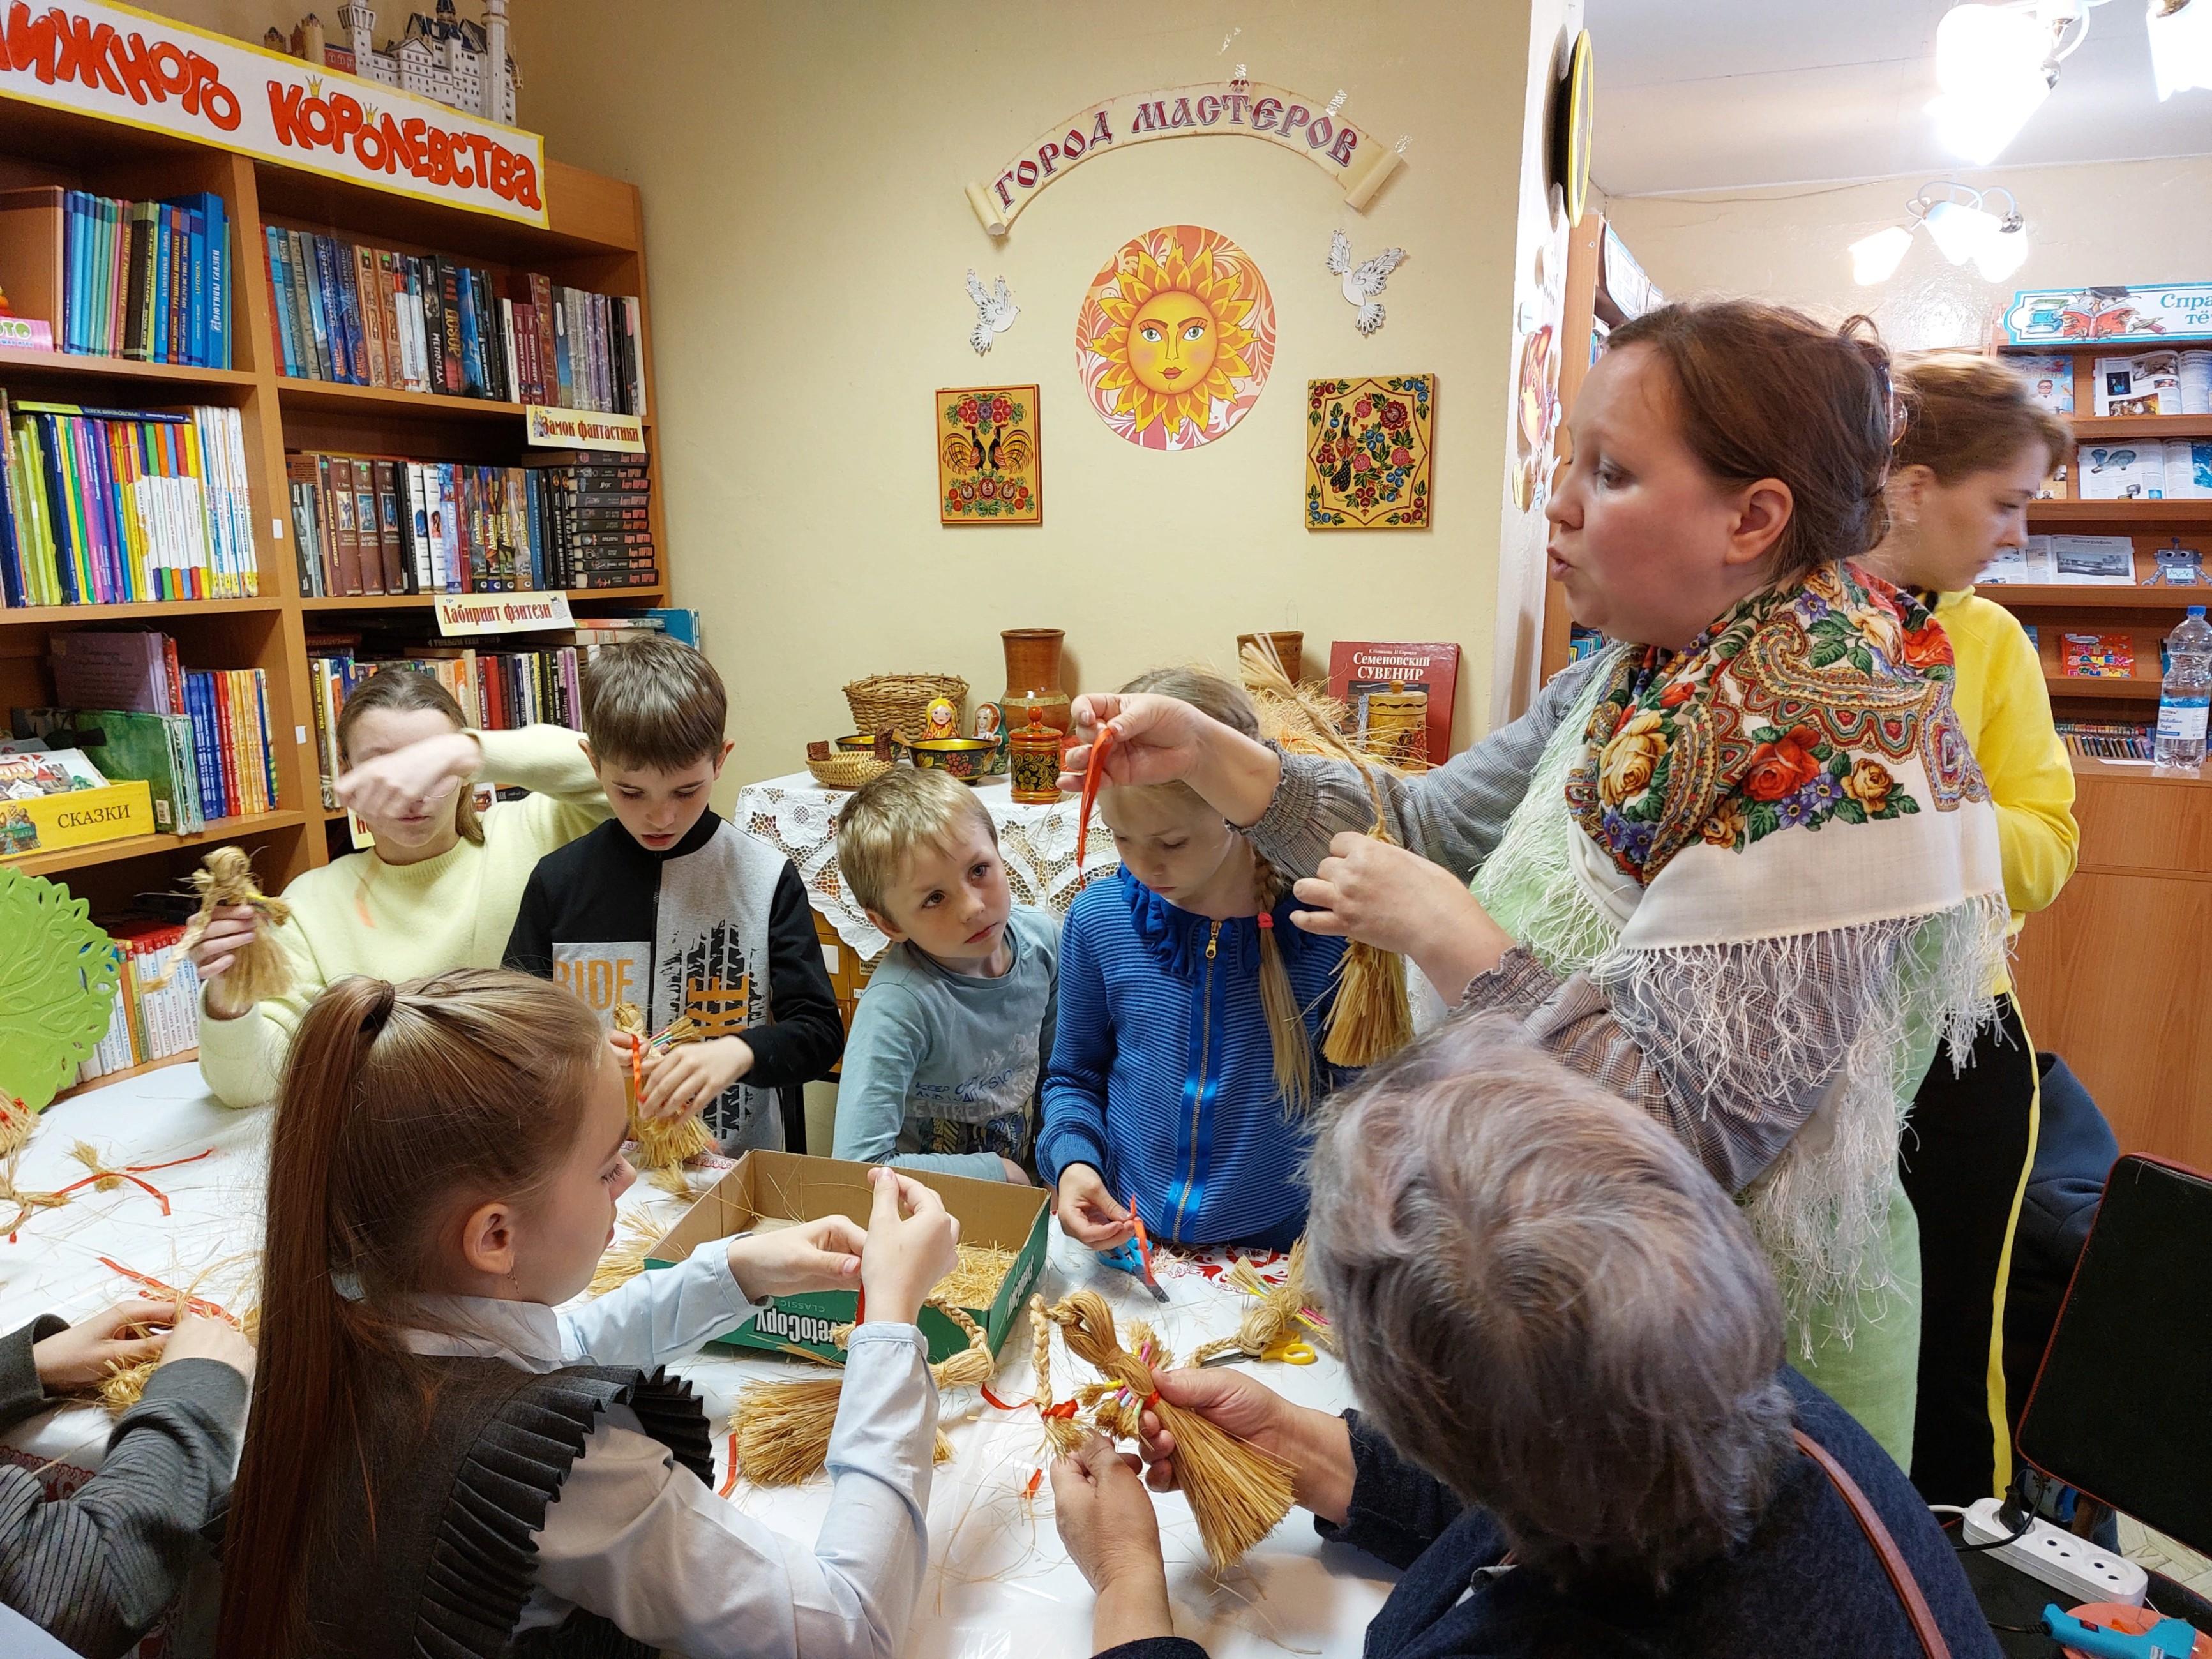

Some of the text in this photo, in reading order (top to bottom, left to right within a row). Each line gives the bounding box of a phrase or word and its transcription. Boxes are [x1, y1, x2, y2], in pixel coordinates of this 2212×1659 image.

[0, 1, 241, 131] ИЖНОГО
[994, 93, 1359, 213] ГОРОД МАСТЕРОВ
[2185, 310, 2212, 324] тё
[431, 333, 444, 384] НЕПОСЕДА
[541, 416, 639, 442] Замок фантастики
[443, 603, 552, 626] Лабиринт фэнтези
[1353, 652, 1430, 667] Семеновский
[1357, 666, 1424, 680] СУВЕНИР
[57, 804, 130, 829] СКАЗКИ
[687, 975, 750, 1037] IKE
[779, 1300, 826, 1314] CLASSIC
[756, 1307, 841, 1345] vetoCopy
